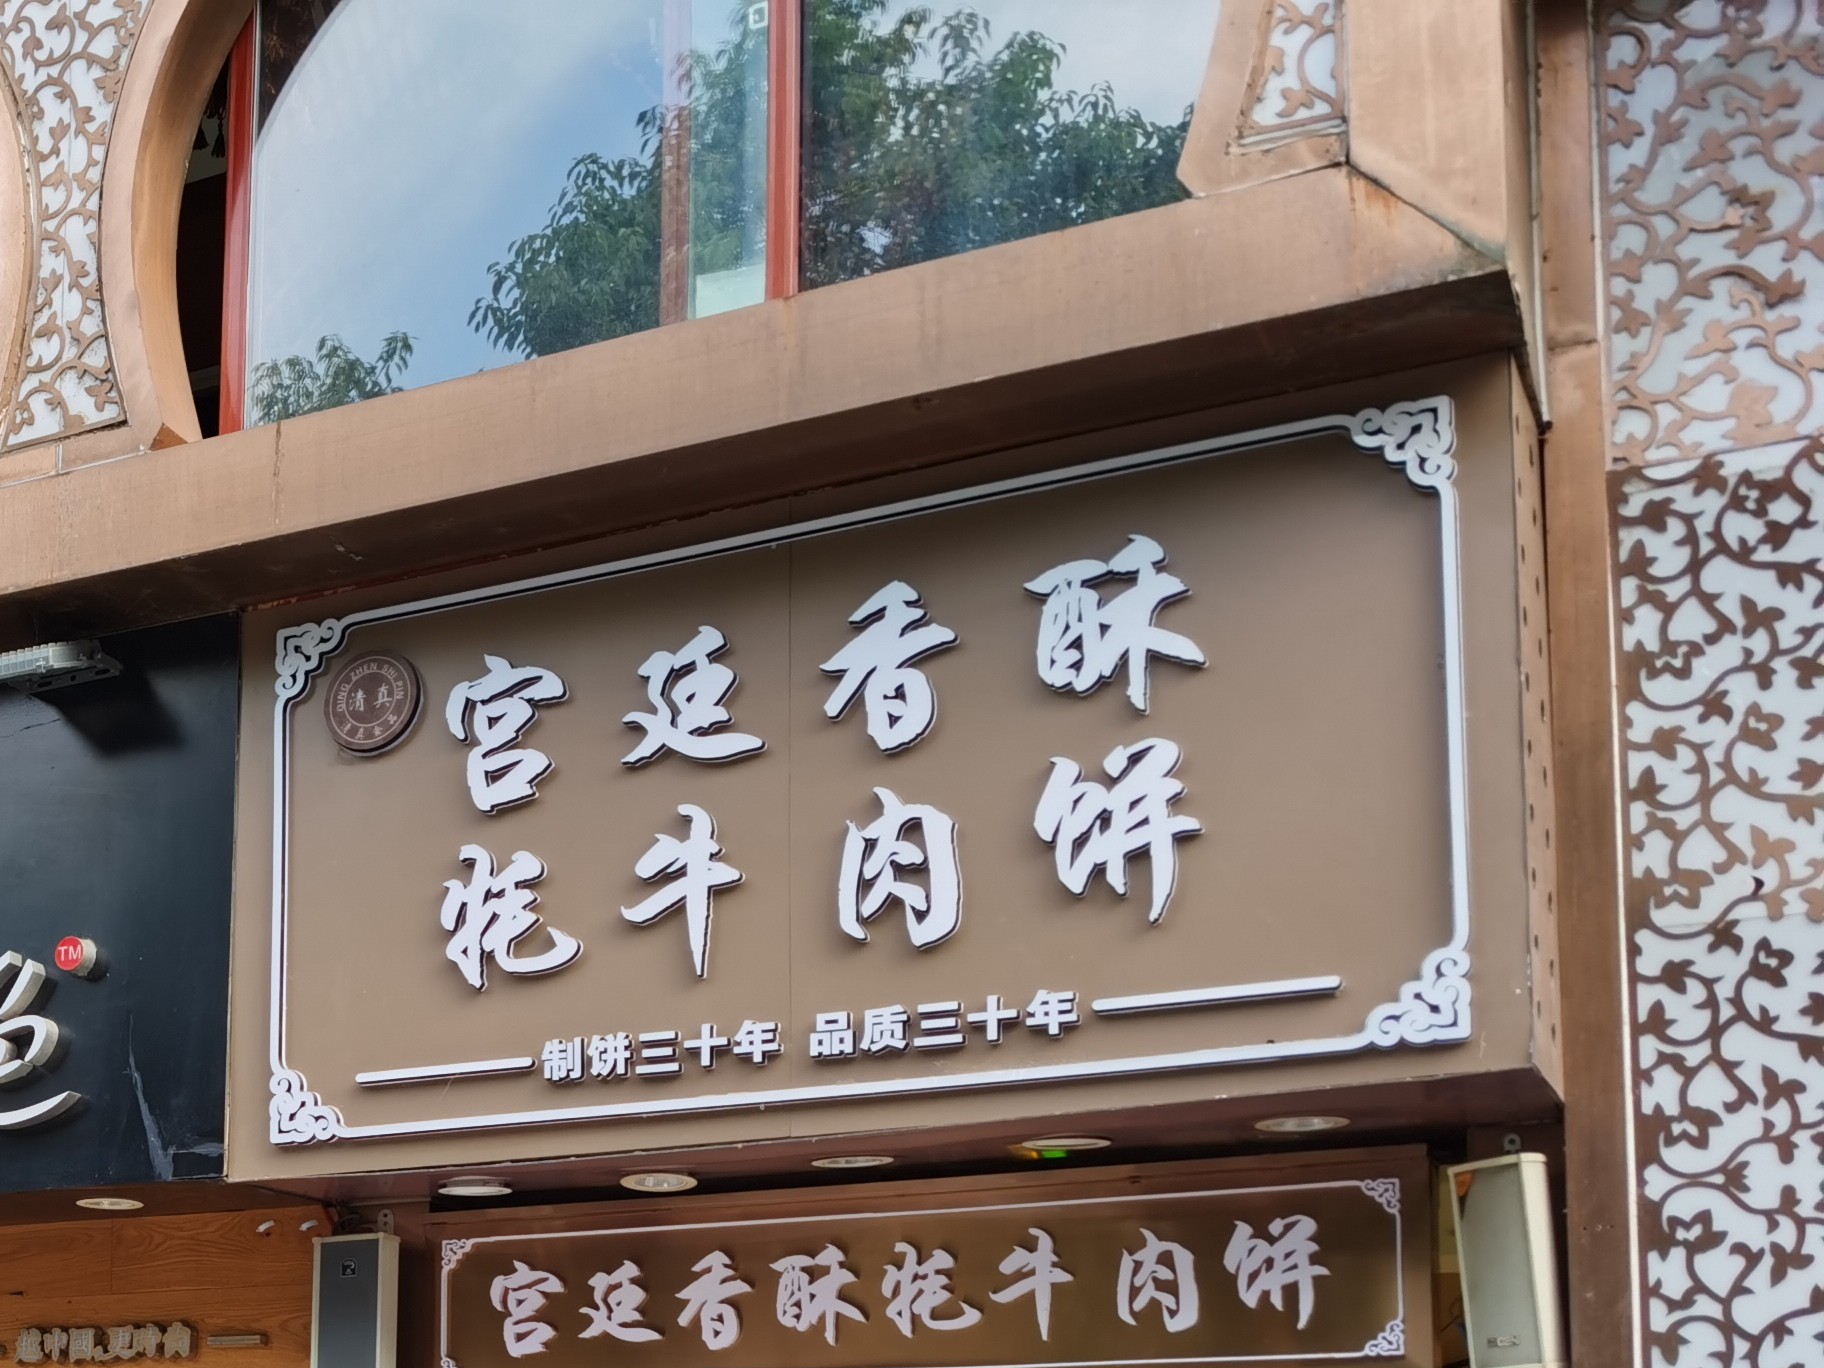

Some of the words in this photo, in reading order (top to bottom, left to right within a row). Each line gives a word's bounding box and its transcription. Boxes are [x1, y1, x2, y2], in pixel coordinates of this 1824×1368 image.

[348, 683, 393, 712] 清真
[349, 662, 379, 681] ZHEN
[382, 664, 398, 680] SHI
[396, 680, 404, 699] PIN
[444, 534, 1207, 815] 宫廷香酥
[439, 738, 1205, 991] 牦牛肉饼
[60, 944, 83, 962] TM
[542, 1016, 783, 1085] 制饼三十年
[808, 989, 1079, 1059] 品质三十年
[489, 1214, 1332, 1361] 宫廷香酥牦牛肉饼
